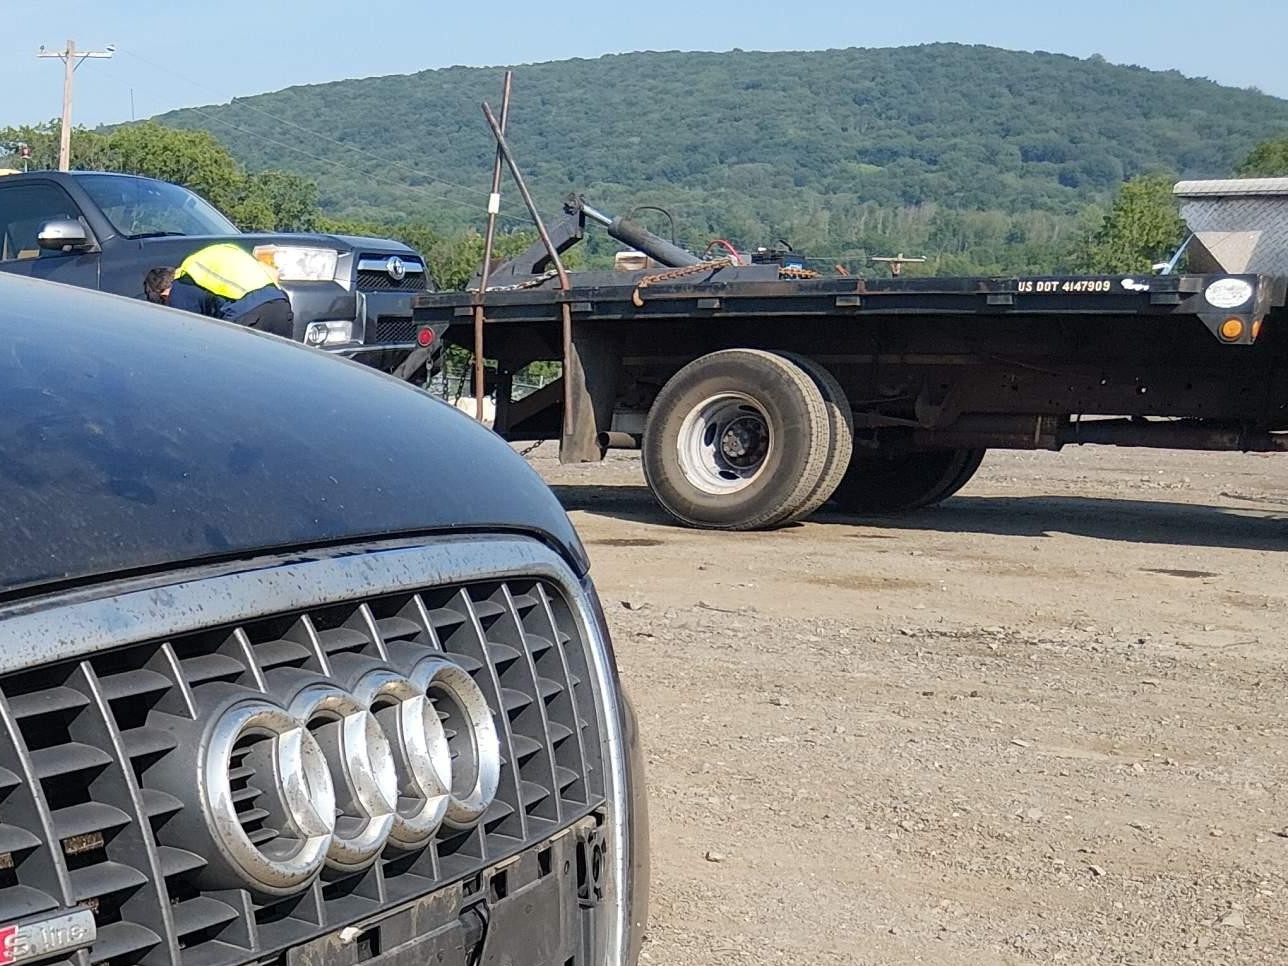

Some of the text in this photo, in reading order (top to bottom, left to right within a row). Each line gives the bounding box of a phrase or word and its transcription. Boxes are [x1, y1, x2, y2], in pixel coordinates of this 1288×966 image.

[1017, 280, 1111, 292] US DOT 4147909
[2, 923, 87, 959] S line
